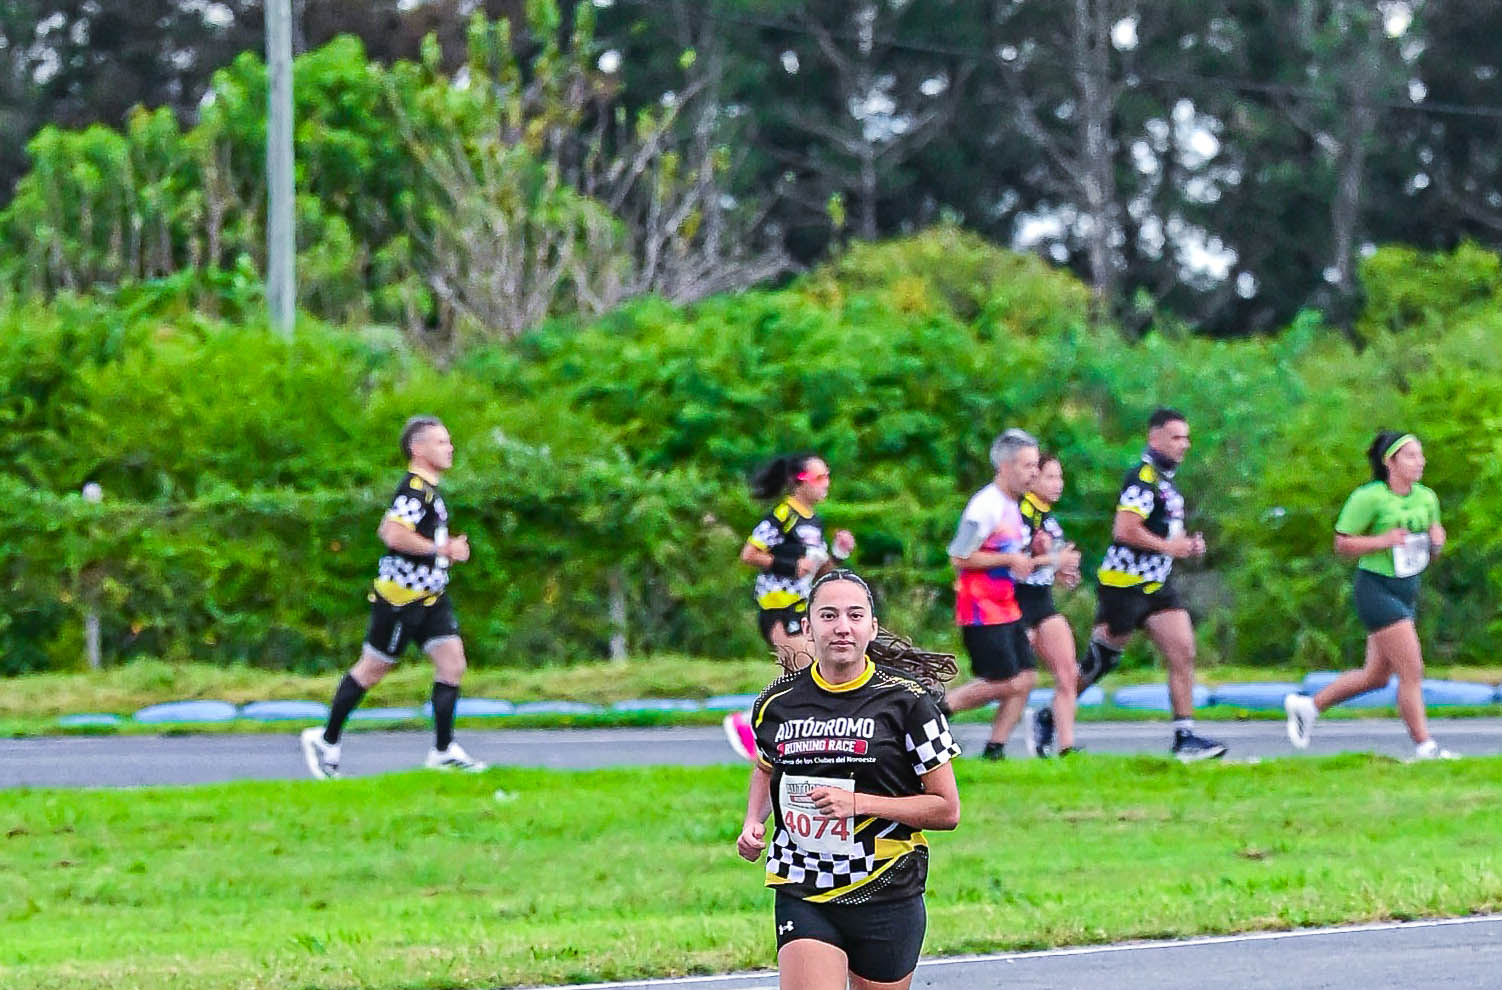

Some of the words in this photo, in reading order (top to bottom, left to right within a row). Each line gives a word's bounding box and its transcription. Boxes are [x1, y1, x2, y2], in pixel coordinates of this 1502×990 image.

[774, 717, 875, 743] AUTÓDROMO
[784, 740, 826, 755] RUNNING
[828, 739, 857, 752] RACE
[785, 811, 850, 841] 4074
